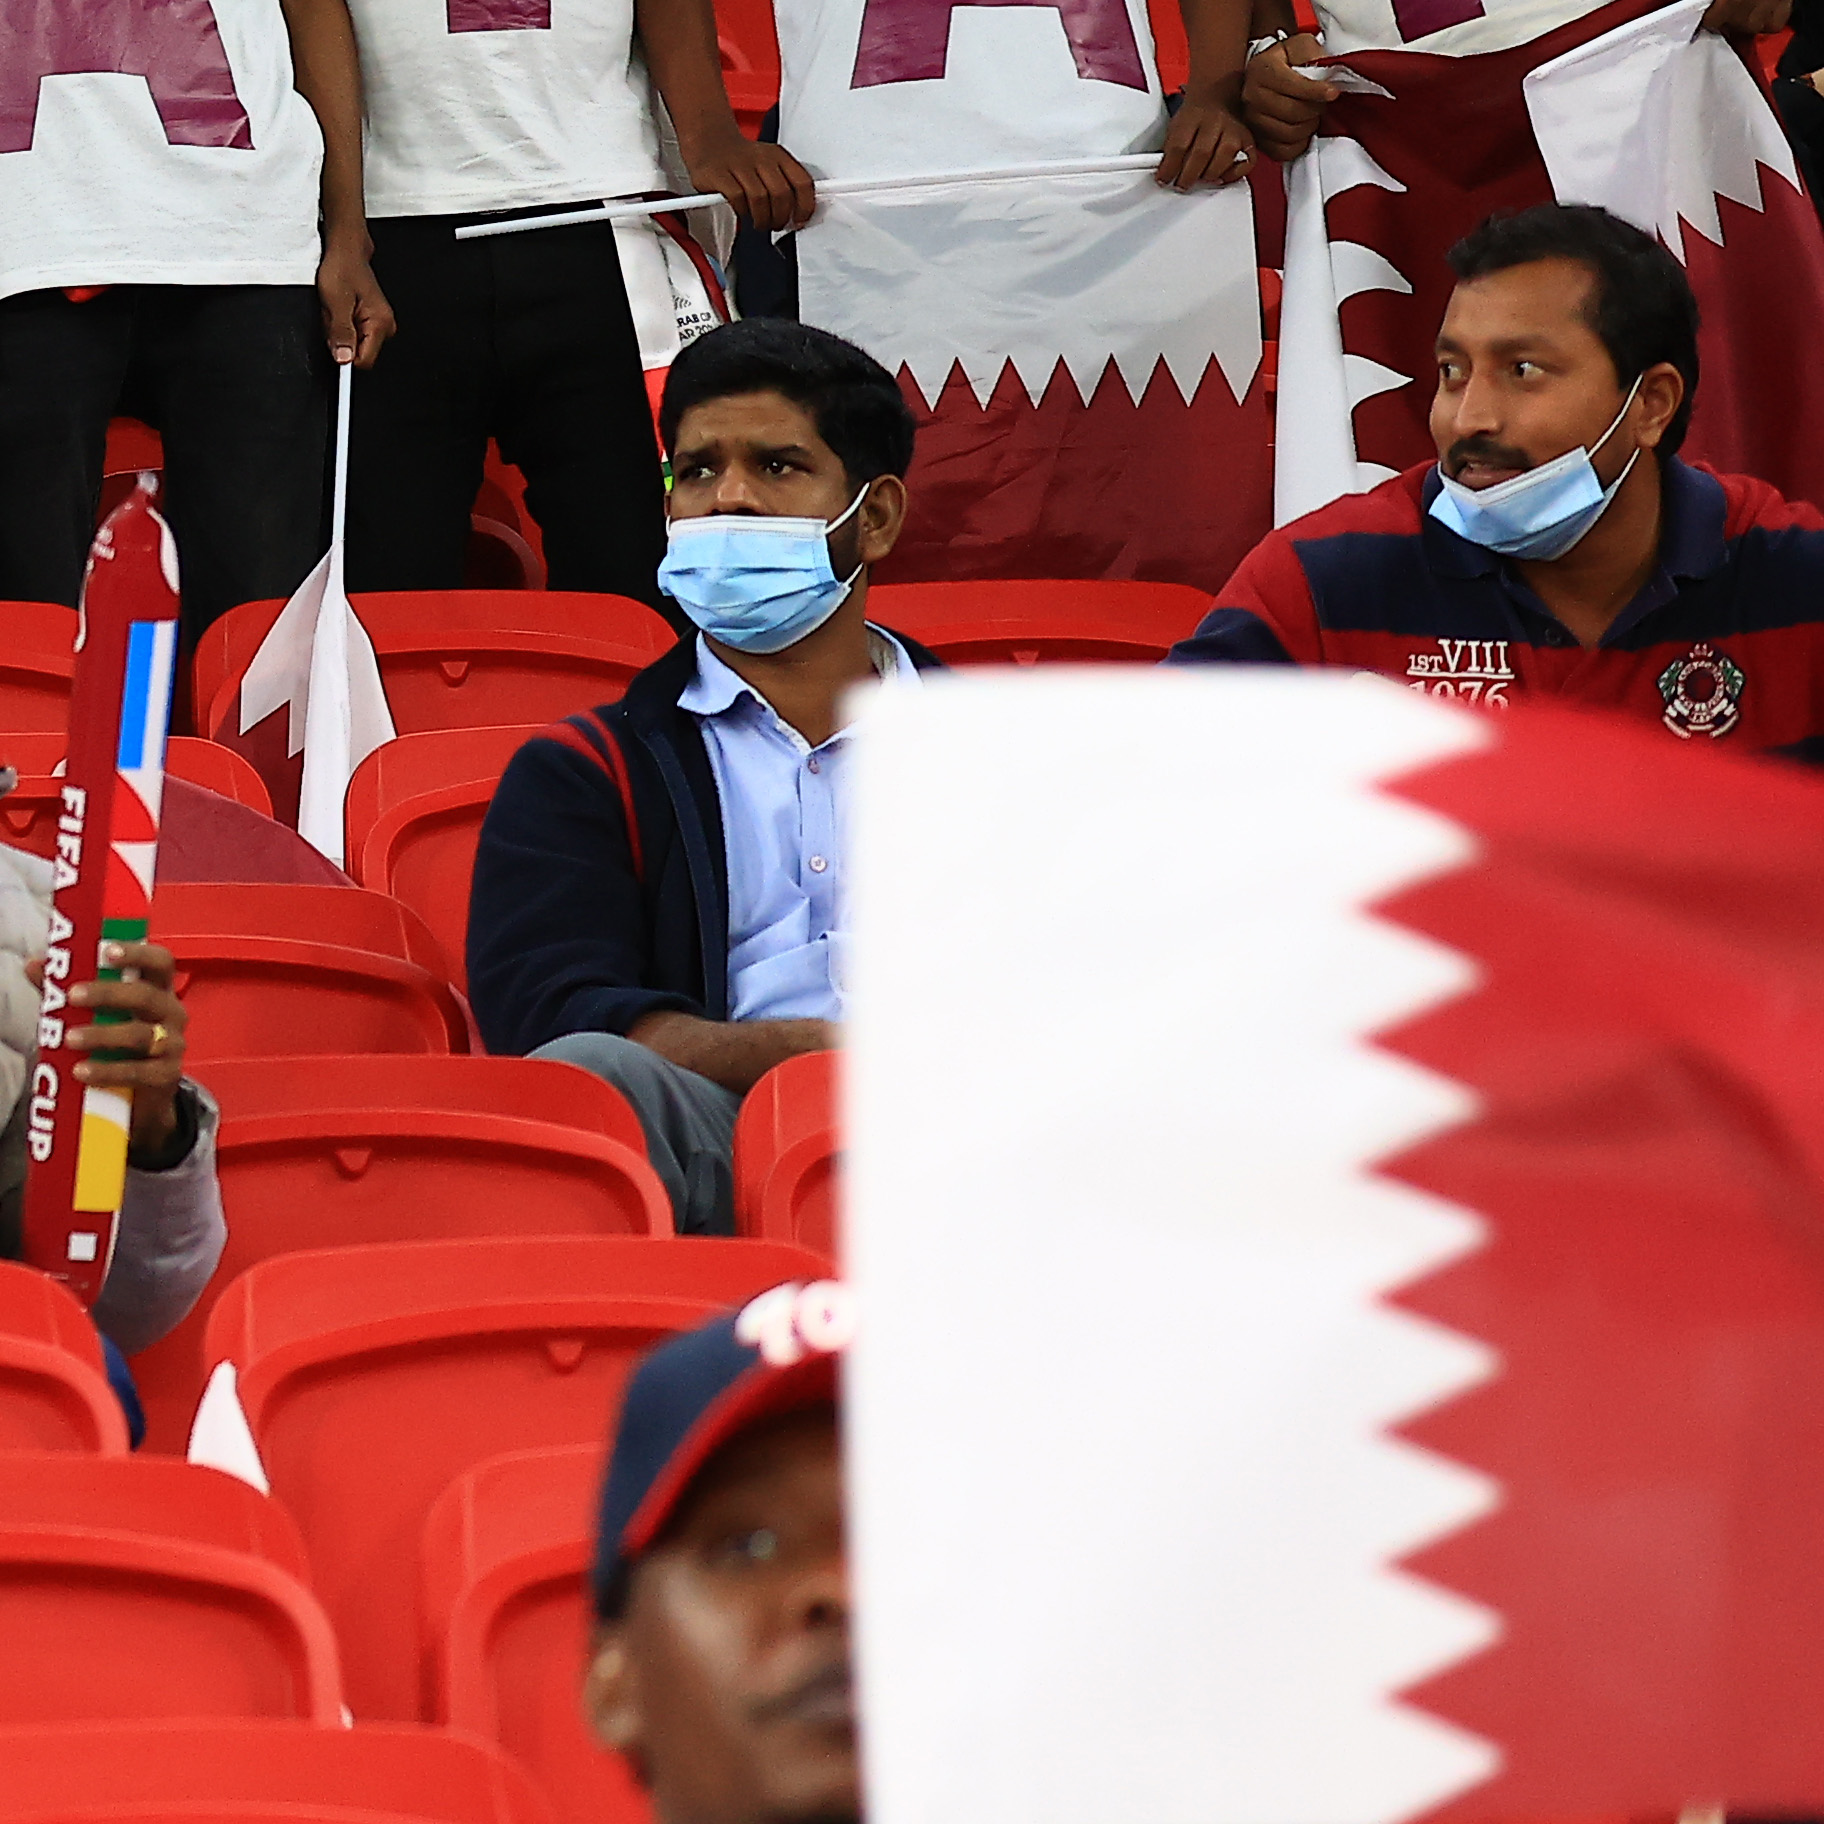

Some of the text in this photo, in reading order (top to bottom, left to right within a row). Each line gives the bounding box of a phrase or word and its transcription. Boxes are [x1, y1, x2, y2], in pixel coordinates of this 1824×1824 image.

[27, 785, 87, 1162] FIFA ARAB CUP
